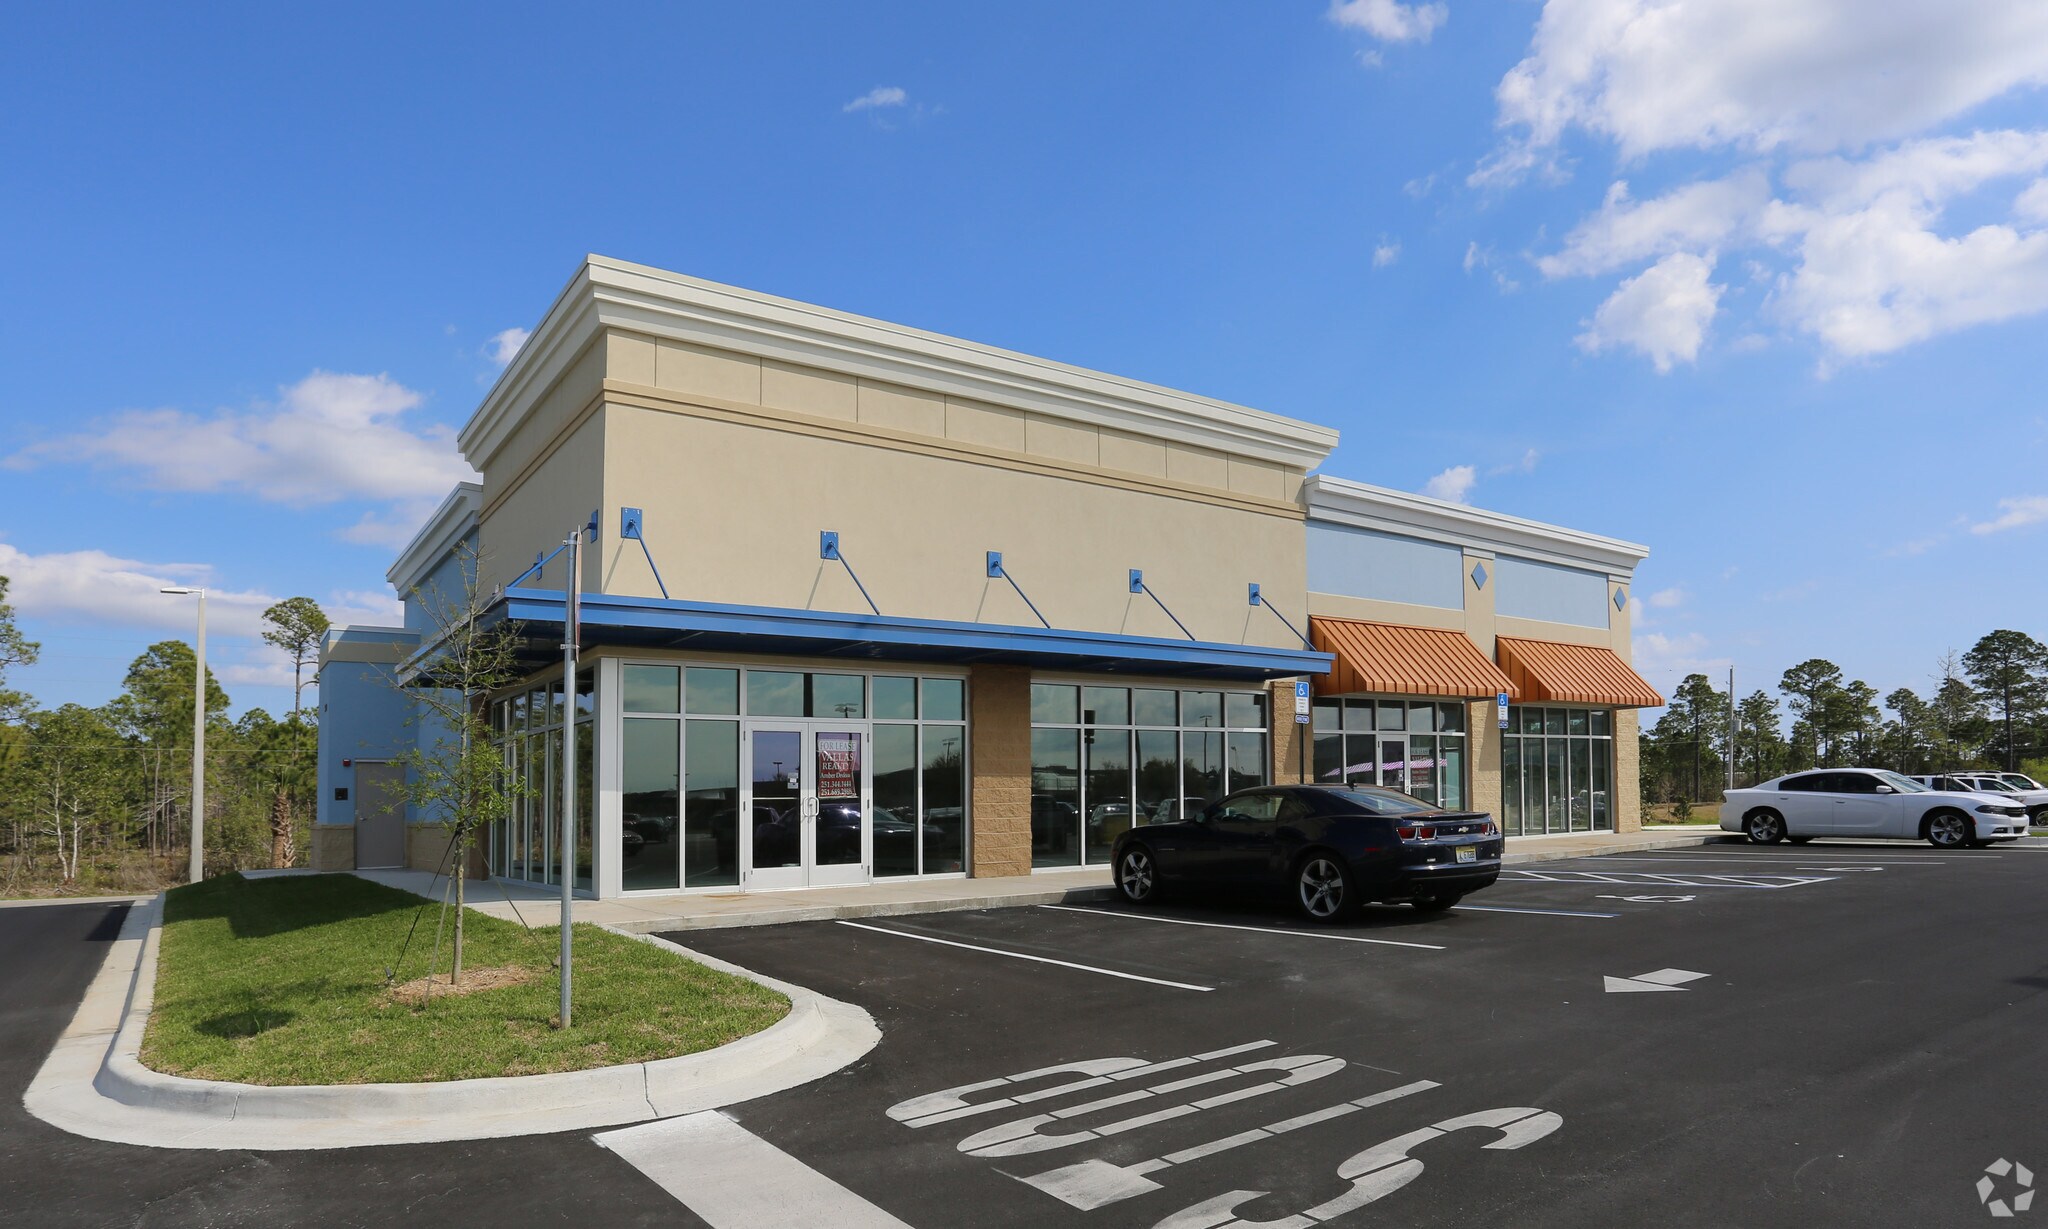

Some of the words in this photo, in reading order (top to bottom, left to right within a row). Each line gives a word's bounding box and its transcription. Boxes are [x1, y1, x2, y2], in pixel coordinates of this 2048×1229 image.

[820, 741, 835, 750] FOR
[836, 742, 856, 750] LEASE
[821, 753, 854, 761] VALLAS
[886, 1040, 1564, 1229] STOP
